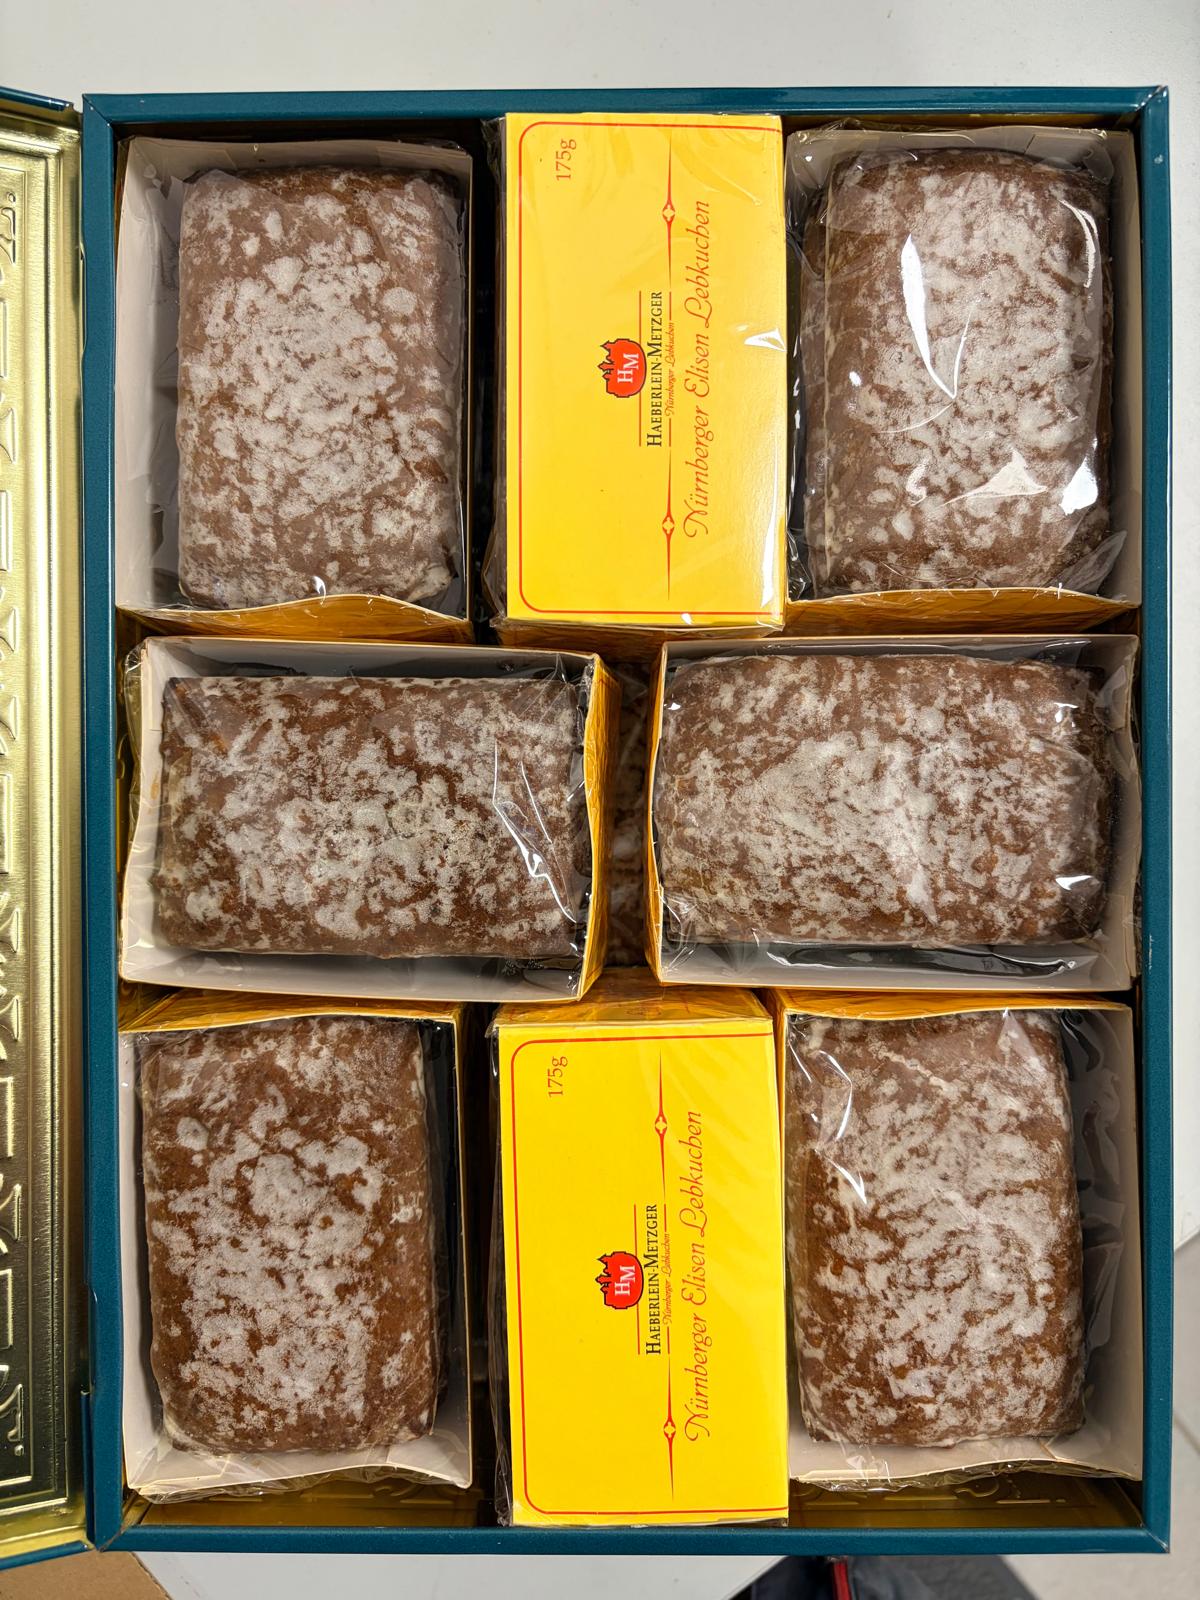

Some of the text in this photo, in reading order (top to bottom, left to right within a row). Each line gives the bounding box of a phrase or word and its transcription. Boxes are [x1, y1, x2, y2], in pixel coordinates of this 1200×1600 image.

[555, 139, 576, 181] 175g
[617, 353, 640, 383] HM
[646, 291, 663, 447] HAEBERLEIN-METZGER
[684, 201, 714, 537] Nürnberger Elisen Lebkuchen
[547, 1056, 568, 1097] 175g
[615, 1265, 636, 1296] HM
[643, 1204, 661, 1355] HAEBERLEIN-METZGER
[679, 1111, 712, 1441] Nürnberger Elisen Lebkuchen
